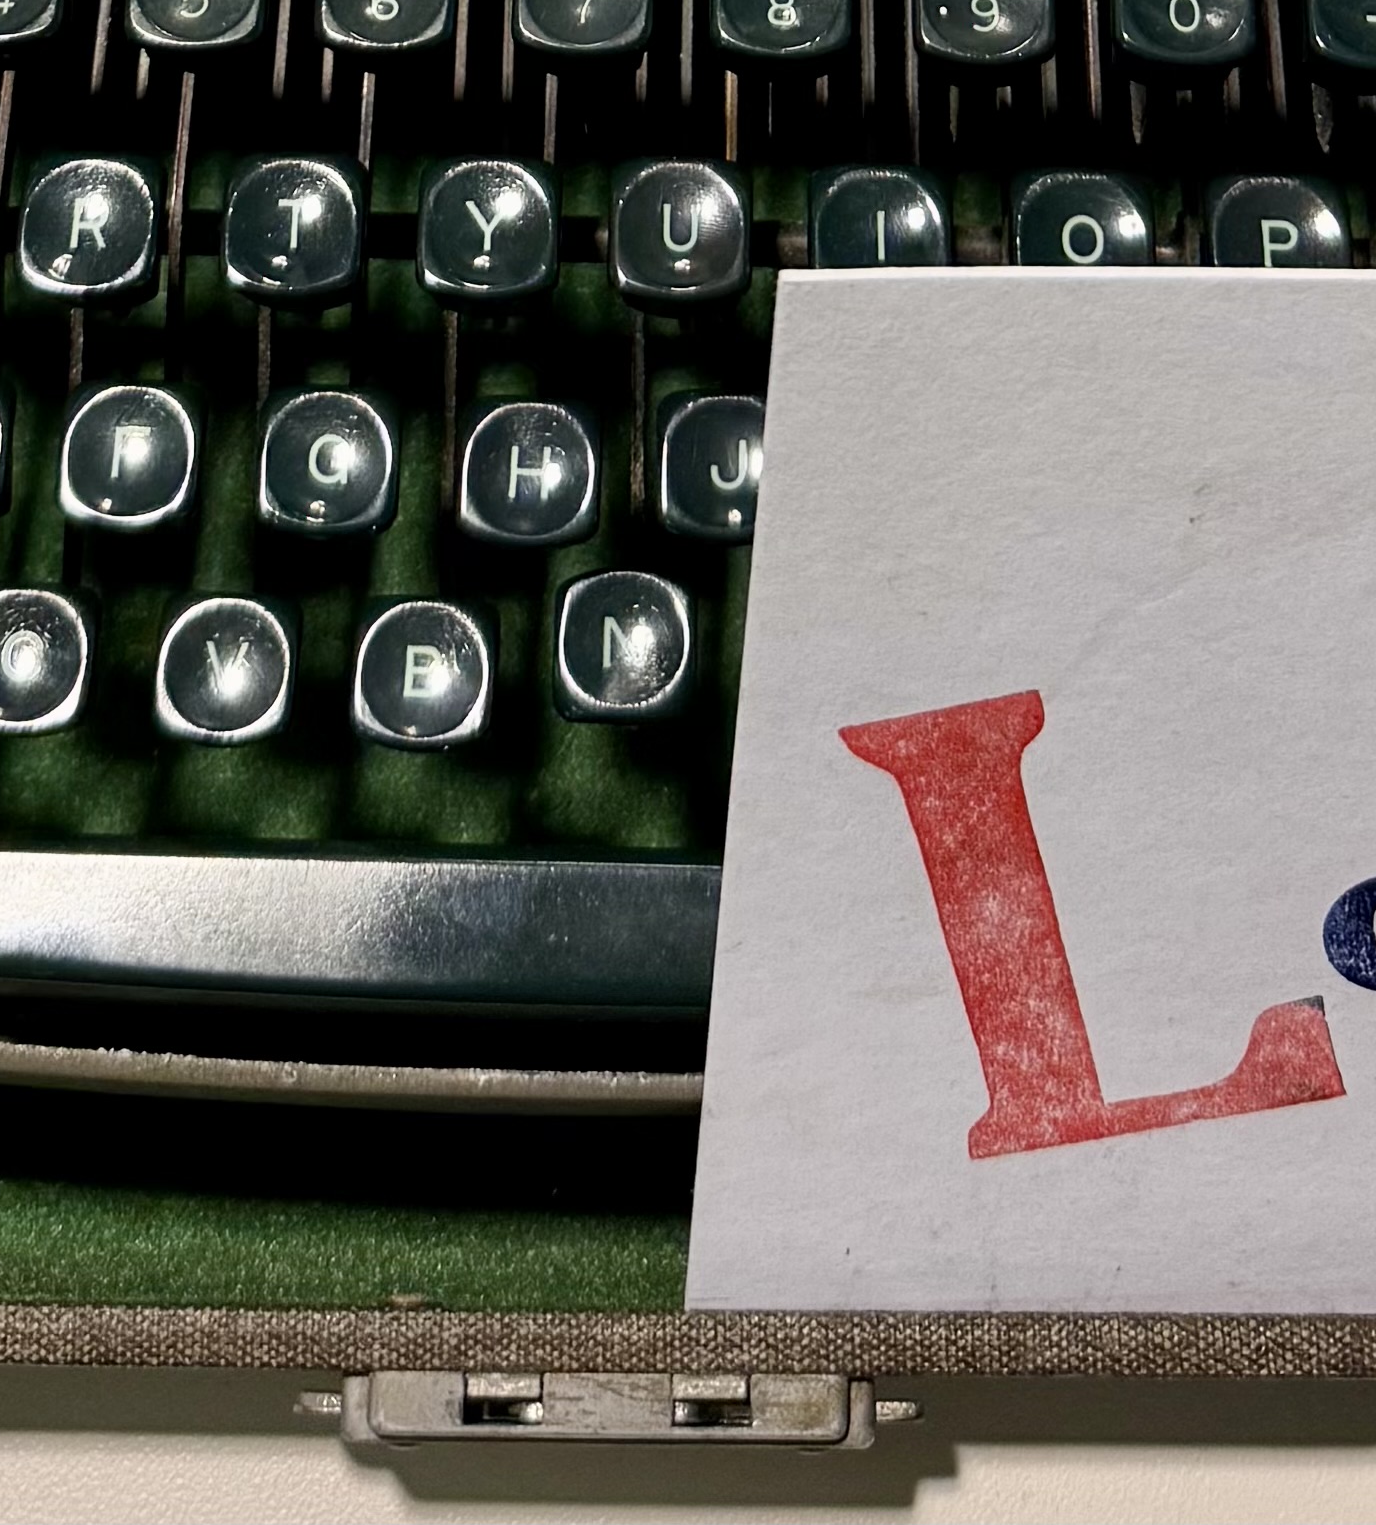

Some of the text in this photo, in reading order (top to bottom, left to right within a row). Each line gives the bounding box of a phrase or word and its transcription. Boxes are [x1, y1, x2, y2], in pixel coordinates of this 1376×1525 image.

[69, 197, 109, 250] R
[277, 198, 315, 250] T
[465, 200, 514, 251] Y
[662, 202, 700, 253] U
[1061, 214, 1104, 264] O
[1260, 219, 1299, 268] P
[508, 444, 554, 501] H
[710, 439, 749, 491] J
